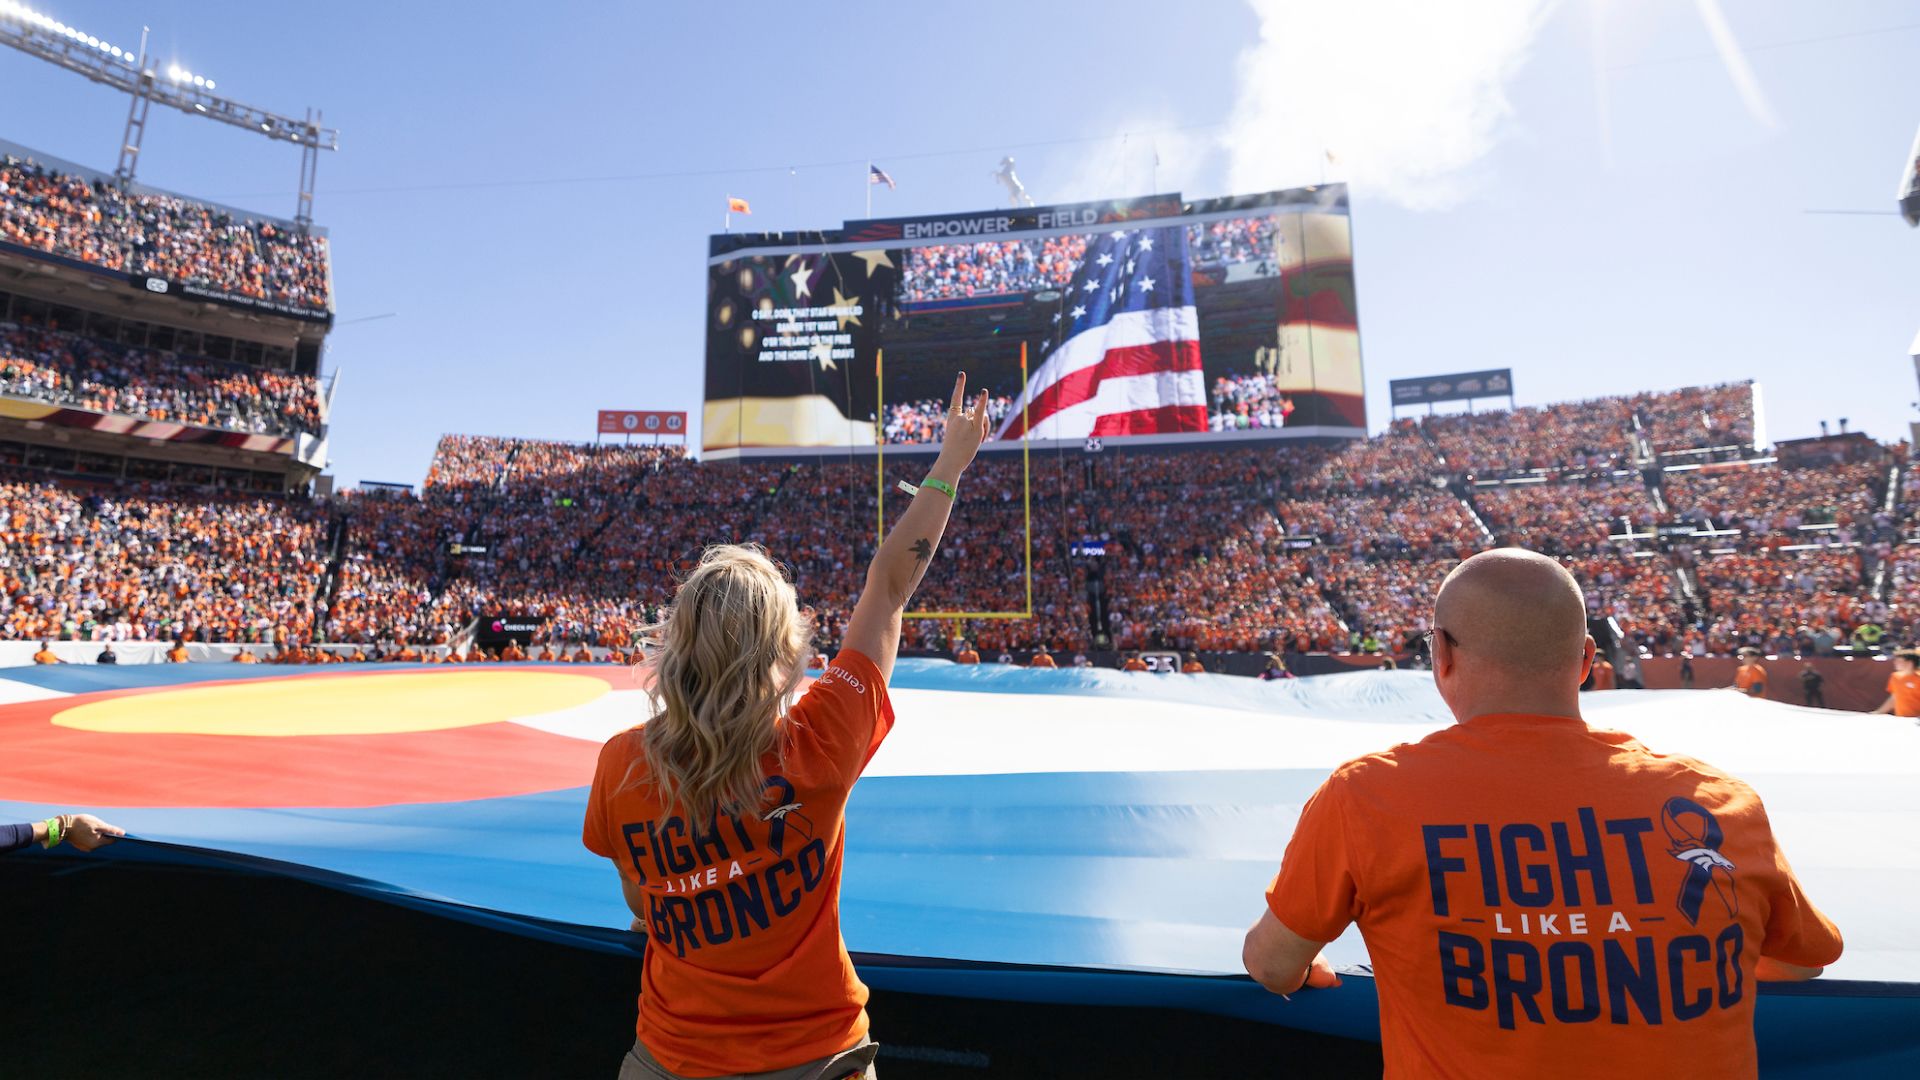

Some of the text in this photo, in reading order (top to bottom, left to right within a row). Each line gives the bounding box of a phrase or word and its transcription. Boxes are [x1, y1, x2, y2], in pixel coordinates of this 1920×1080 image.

[903, 208, 1098, 240] EMPOWER FIELD
[1086, 439, 1101, 451] 25
[830, 665, 866, 694] centu
[622, 797, 755, 886] FIGHT
[666, 860, 744, 893] LIKE A
[1422, 806, 1656, 917] FIGHT
[650, 838, 826, 958] BRONCO
[1495, 911, 1632, 935] LIKE A
[1438, 922, 1744, 1030] BRONCO
